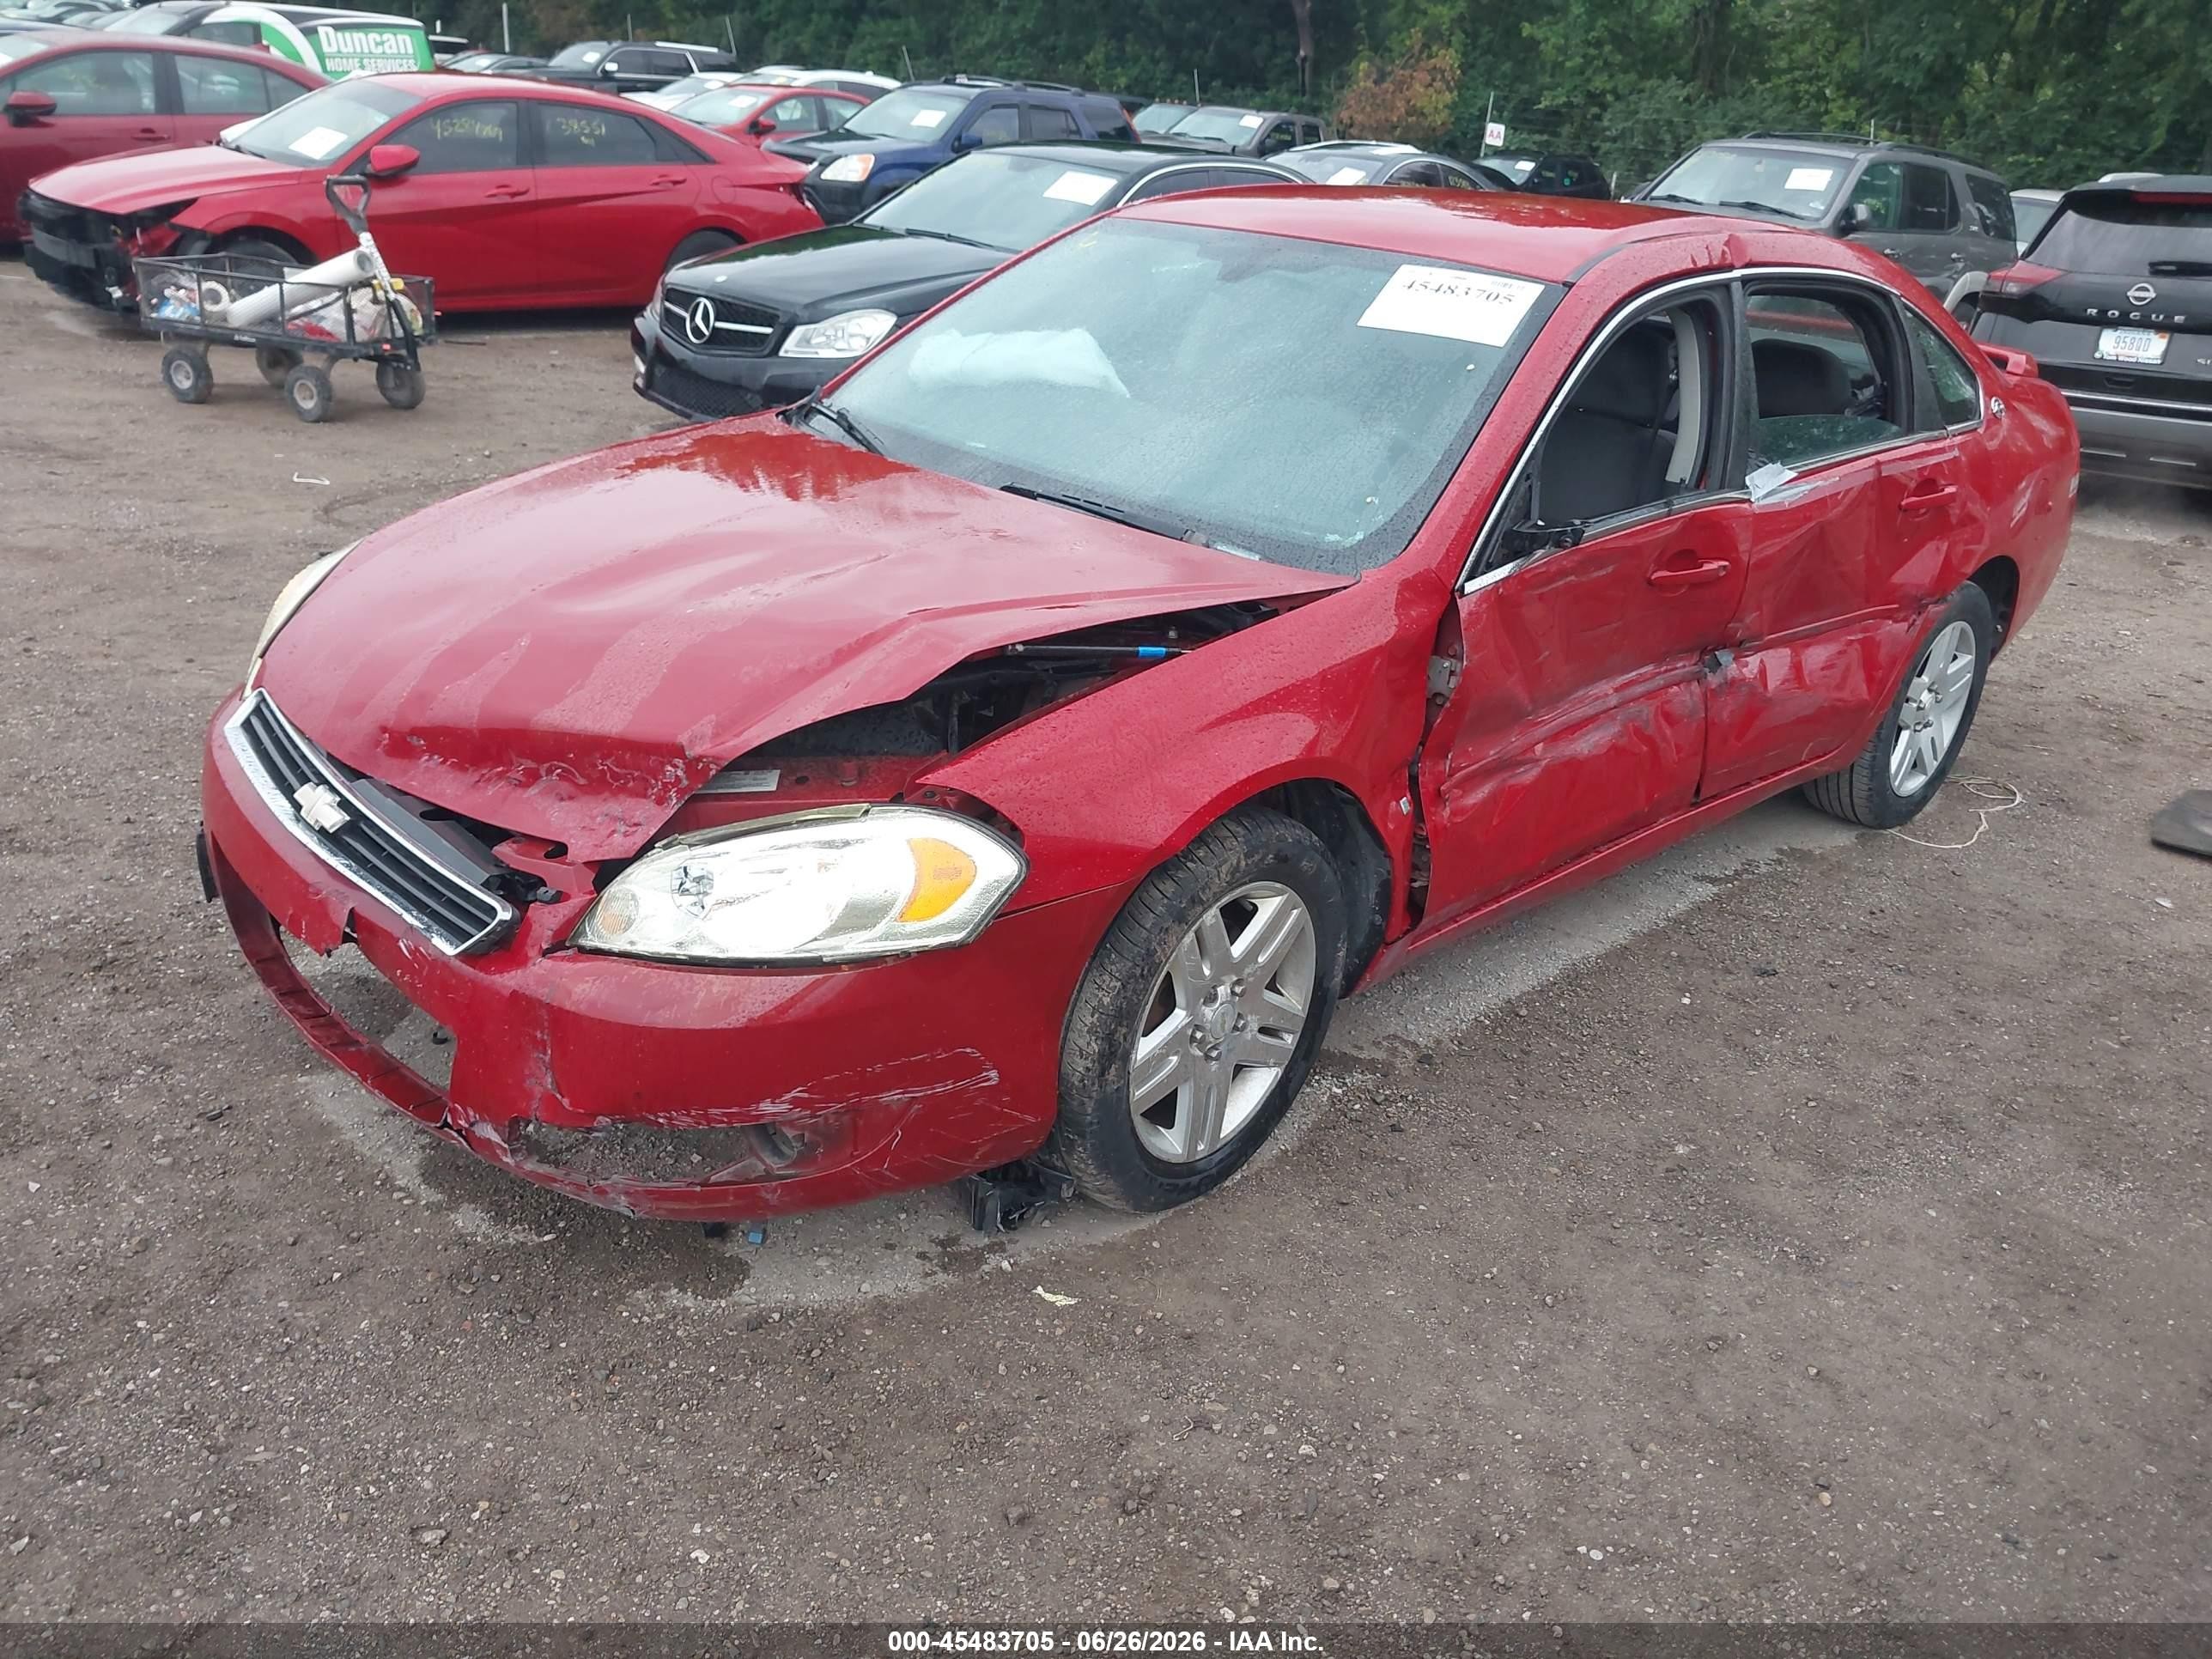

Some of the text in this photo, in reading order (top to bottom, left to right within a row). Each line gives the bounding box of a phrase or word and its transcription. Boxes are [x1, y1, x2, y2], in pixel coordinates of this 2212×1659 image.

[317, 26, 414, 54] Duncan
[325, 56, 420, 72] HOME SERVICES
[1402, 280, 1516, 305] 45483705
[2087, 308, 2186, 324] ROGUE
